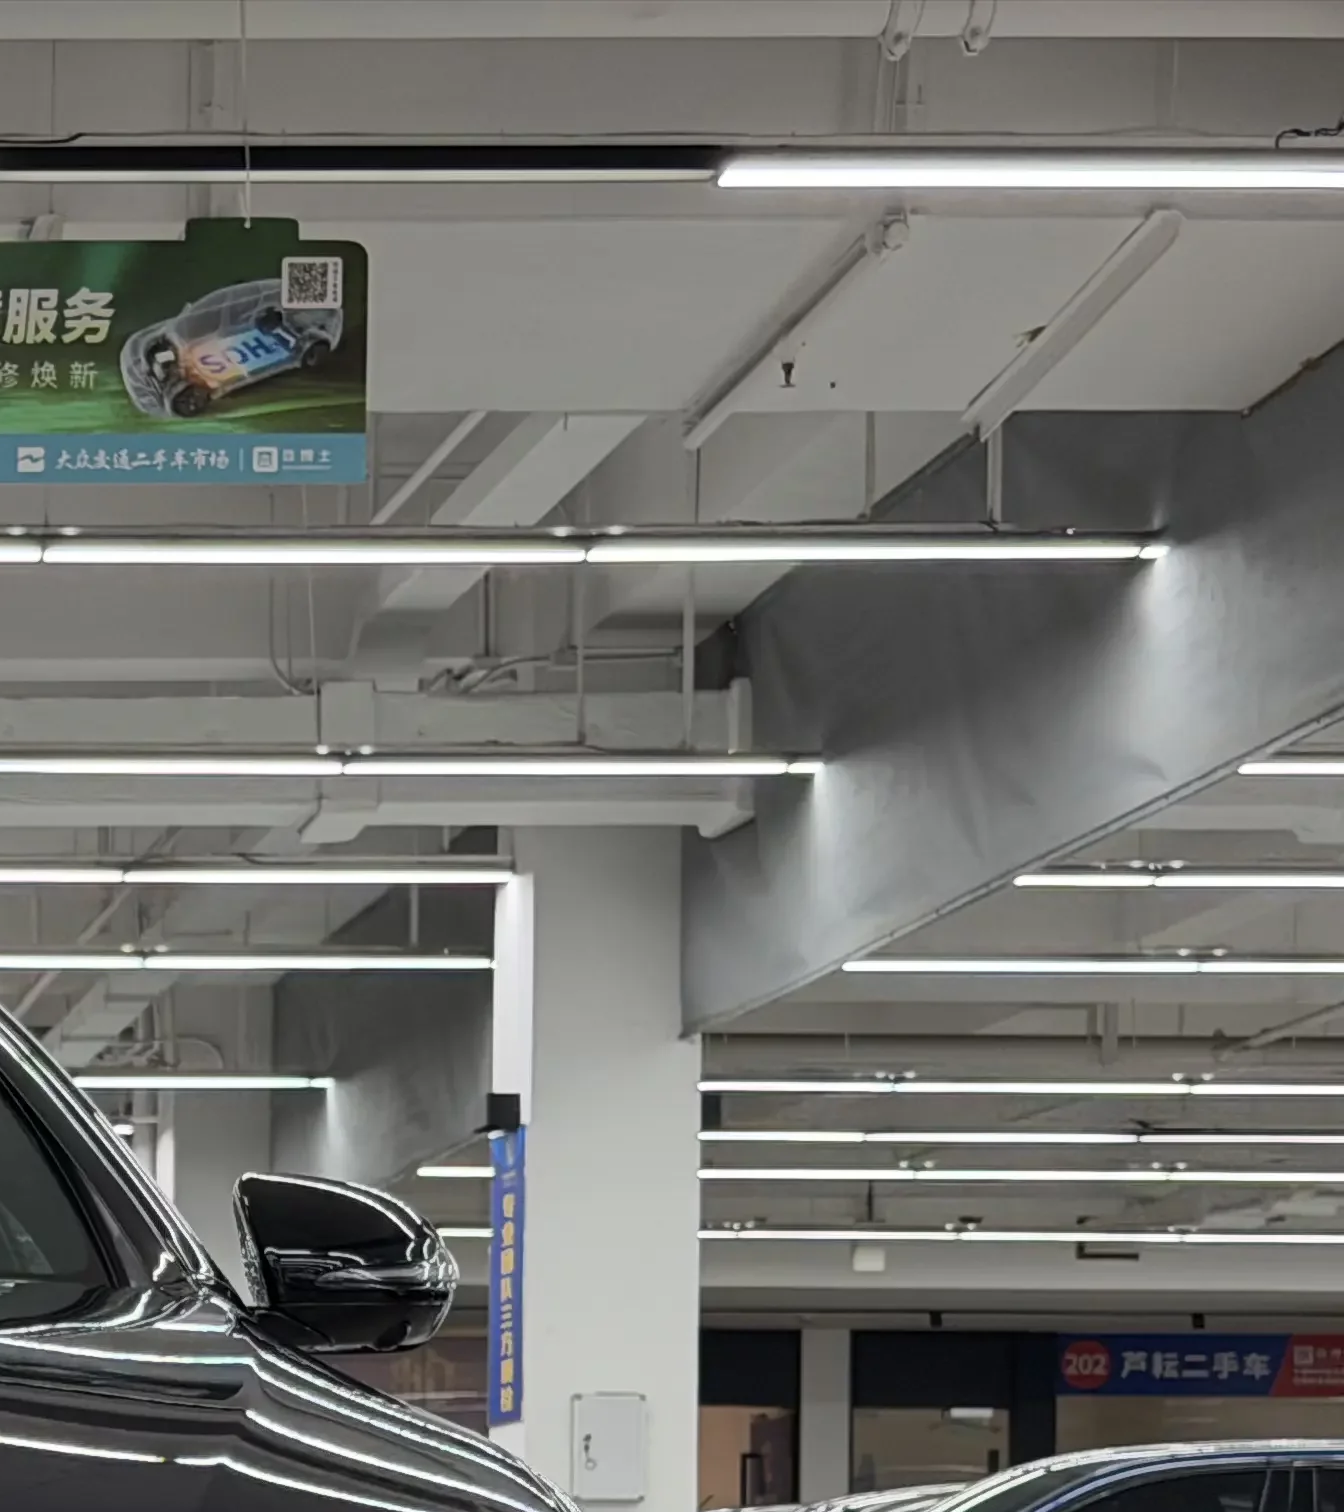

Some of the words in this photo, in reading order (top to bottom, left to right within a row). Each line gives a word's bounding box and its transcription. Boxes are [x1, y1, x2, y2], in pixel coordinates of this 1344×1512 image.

[54, 447, 230, 472] 大众交通二手车市场
[1064, 1352, 1110, 1376] 202
